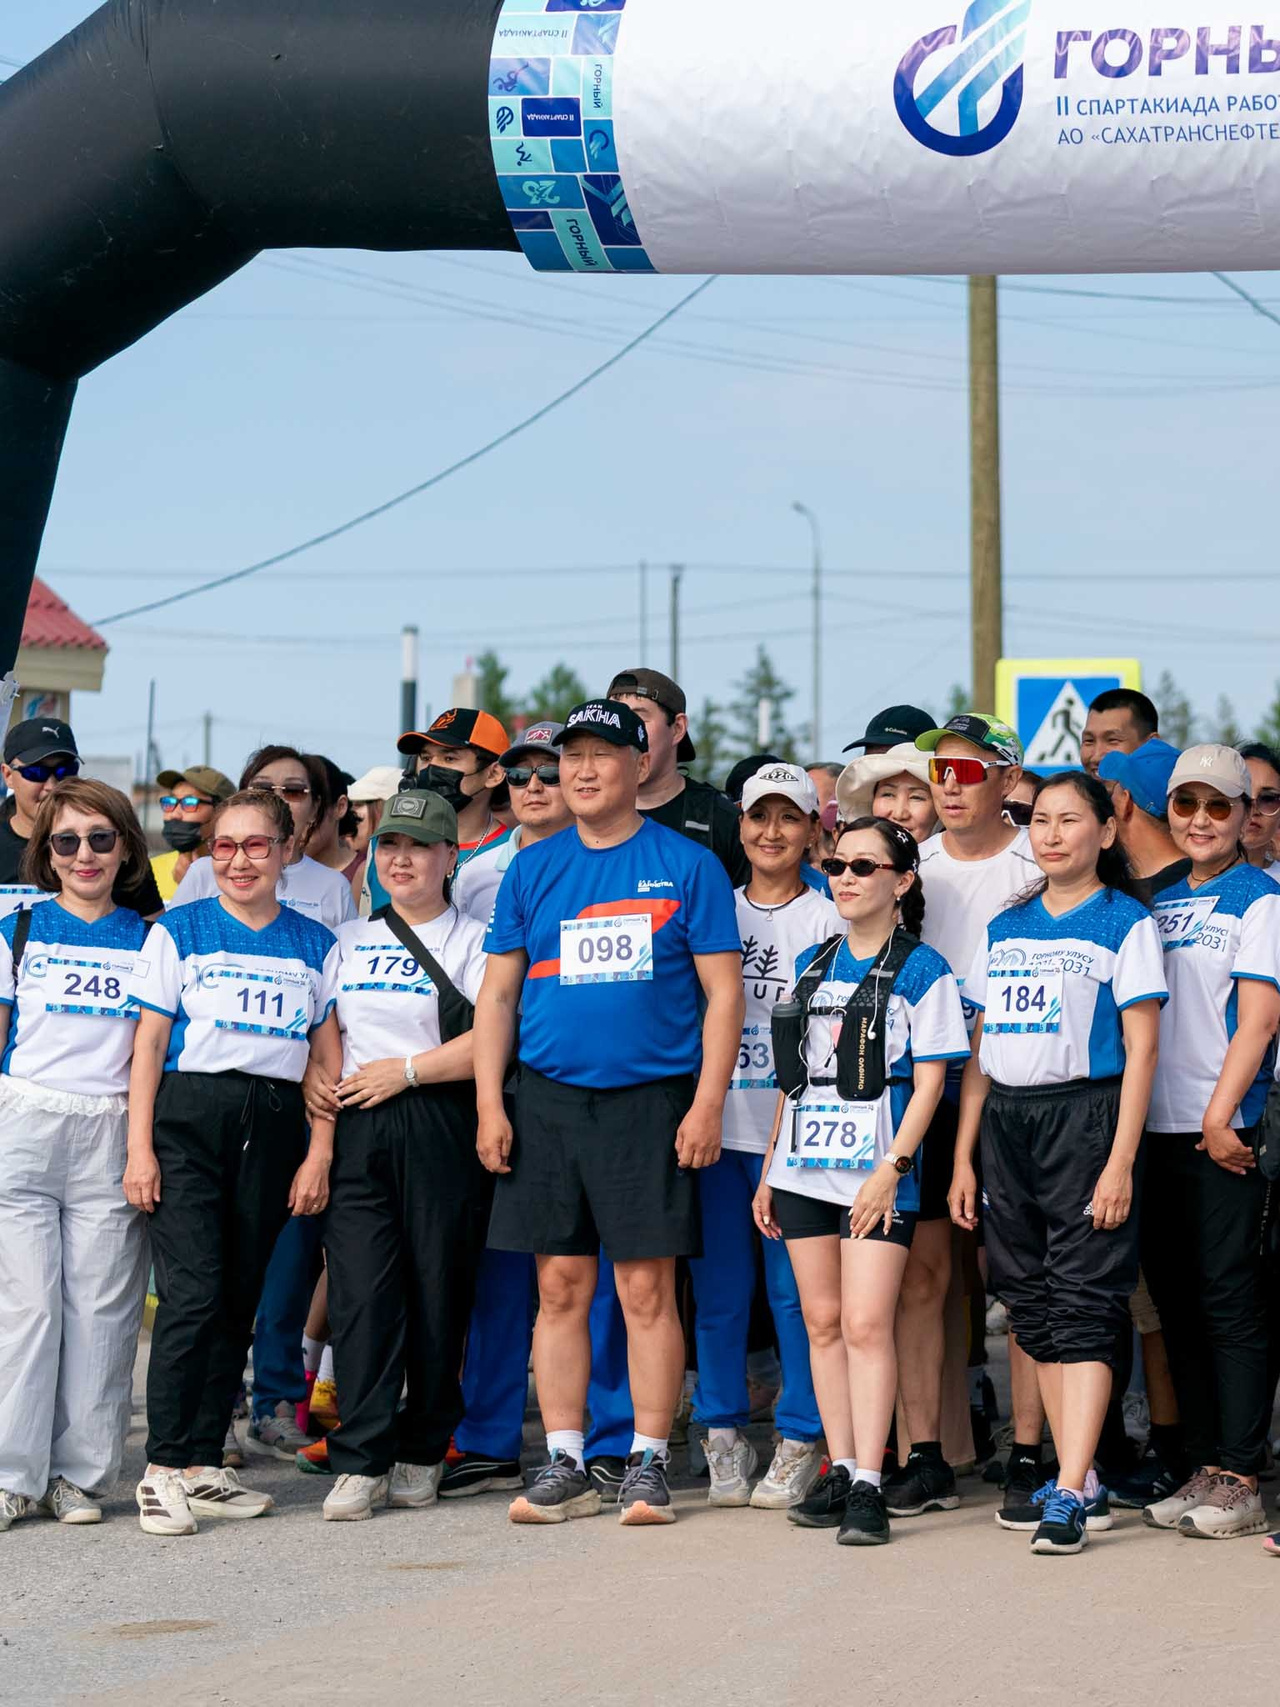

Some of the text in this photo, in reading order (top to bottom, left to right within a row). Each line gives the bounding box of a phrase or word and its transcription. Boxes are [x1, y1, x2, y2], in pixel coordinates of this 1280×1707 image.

[593, 64, 602, 109] ГОРНЫЙ
[1057, 96, 1069, 116] II
[1077, 95, 1221, 116] СПАРТАКИАДА
[1057, 127, 1085, 146] АО
[566, 218, 594, 268] ГОРНЫЙ
[566, 708, 621, 729] SAKHA
[1158, 912, 1195, 934] 251
[578, 934, 633, 964] 098
[1066, 950, 1095, 964] УЛУСУ
[367, 955, 421, 977] 179
[64, 973, 121, 999] 248
[1001, 985, 1046, 1012] 184
[237, 987, 284, 1017] 111
[858, 1017, 868, 1055] МАРАФОН
[739, 1042, 770, 1069] 63
[803, 1120, 857, 1148] 278
